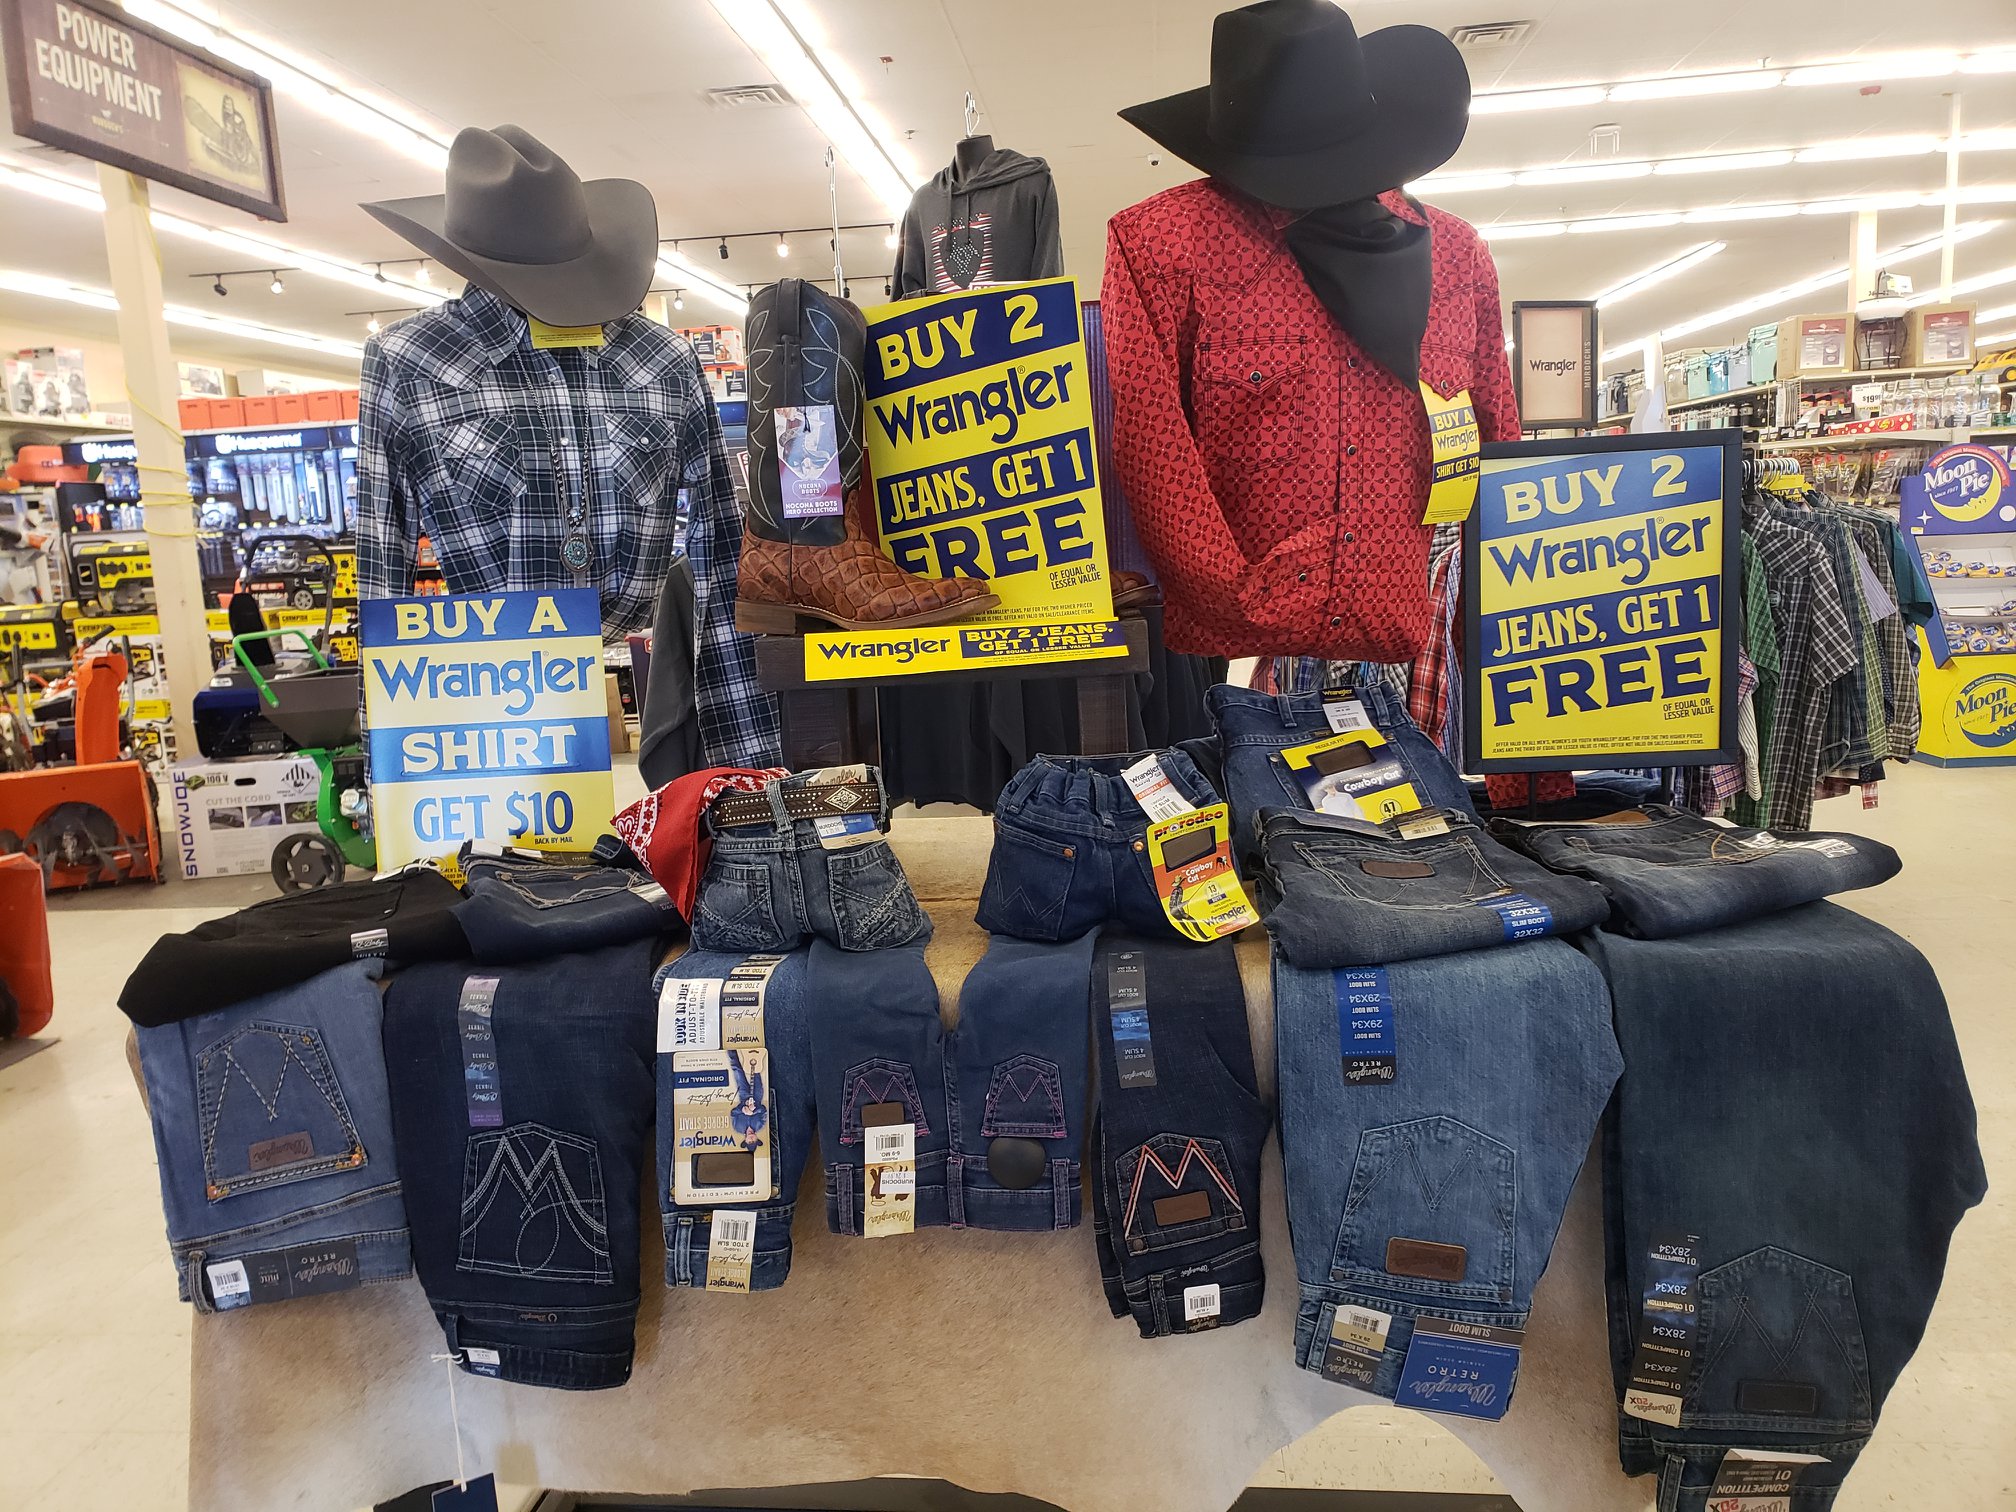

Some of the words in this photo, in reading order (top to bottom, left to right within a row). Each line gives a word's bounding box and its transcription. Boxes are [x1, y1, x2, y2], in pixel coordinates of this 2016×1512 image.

[55, 3, 137, 71] POWER
[34, 38, 162, 121] EQUIPMENT
[875, 307, 978, 382] BUY
[1003, 293, 1044, 346] 2
[1529, 359, 1577, 376] Wrangler
[873, 361, 1074, 449] Wrangler
[1433, 412, 1459, 431] BUY
[1464, 409, 1474, 423] A
[233, 431, 303, 453] Husqvarna
[1435, 429, 1478, 451] Wrangler
[1436, 462, 1455, 479] SHIRT
[1455, 459, 1468, 473] GET
[1469, 456, 1479, 470] $10
[889, 465, 987, 525] JEANS,
[992, 447, 1055, 500] GET
[1065, 437, 1087, 482] 1
[1923, 459, 1978, 493] Moon
[1501, 465, 1624, 525] BUY
[1650, 454, 1689, 498] 2
[1959, 472, 1990, 497] Pie
[802, 506, 838, 514] COLLECTION
[814, 500, 838, 508] BOOTS
[1488, 513, 1712, 586] Wrangler
[1049, 572, 1059, 582] OF
[1061, 566, 1085, 579] EQUAL
[1086, 563, 1097, 574] OR
[1051, 579, 1077, 590] LESSER
[1078, 572, 1102, 584] VALUE
[394, 598, 506, 641] BUY
[528, 596, 568, 633] A
[1492, 602, 1607, 658] JEANS,
[1616, 588, 1683, 633] GET
[1693, 583, 1712, 625] 1
[966, 629, 1012, 643] BUY
[1017, 628, 1031, 639] 2
[978, 639, 1022, 652] GET
[1031, 638, 1039, 648] 1
[1048, 633, 1105, 646] FREE
[818, 637, 950, 664] Wrangler
[371, 650, 596, 716] Wrangler
[1487, 637, 1712, 728] FREE
[1322, 689, 1353, 697] Wrangler
[1662, 703, 1673, 713] OF
[1674, 700, 1696, 712] EQUAL
[1698, 697, 1712, 708] OR
[1954, 687, 2007, 719] Moon
[1663, 709, 1690, 721] LESSER
[1691, 705, 1715, 717] VALUE
[1990, 700, 2016, 724] Pie
[402, 724, 577, 773] SHIRT
[1314, 741, 1337, 750] REGULAR
[206, 775, 221, 784] 100
[1129, 764, 1160, 784] Wrangler
[1344, 777, 1383, 792] Cowboy
[1383, 770, 1402, 780] Cut
[205, 798, 223, 806] CUT
[223, 796, 242, 804] THE
[244, 794, 271, 803] CORD
[1383, 801, 1396, 813] 47
[173, 771, 198, 876] SNOWJOE
[413, 794, 491, 843] GET
[505, 790, 574, 840] $10
[534, 836, 550, 845] BACK
[550, 836, 559, 844] BY
[559, 835, 574, 843] MAIL
[1185, 861, 1214, 876] Cowboy
[1187, 874, 1200, 883] Cut
[1207, 884, 1217, 893] 13
[1202, 904, 1247, 927] Wrangler
[1509, 907, 1541, 917] 32X32
[1511, 920, 1527, 928] SLIM
[1527, 916, 1546, 925] BOOT
[1513, 927, 1544, 939] 32X32
[1345, 972, 1377, 980] 29X34
[699, 983, 709, 1010] WAISTBAND
[1349, 993, 1380, 1004] 29X34
[675, 1017, 687, 1046] LOOK
[1351, 1019, 1383, 1029] 29X34
[726, 1033, 760, 1043] Wrangler
[690, 1075, 725, 1083] ORIGINAL
[1121, 1069, 1154, 1080] Wrangler
[1345, 1065, 1394, 1081] Wrangler
[677, 1116, 701, 1131] STRAIT
[703, 1115, 730, 1130] GEORGE
[679, 1131, 737, 1149] Wrangler
[867, 1209, 911, 1225] Wrangler
[301, 1252, 336, 1264] RETRO
[1650, 1252, 1686, 1263] COMPETITION
[1659, 1244, 1691, 1257] 28X34
[1686, 1257, 1697, 1266] 01
[294, 1257, 353, 1282] Wrangler
[709, 1276, 746, 1290] Wrangler
[1654, 1281, 1687, 1296] 28X34
[1646, 1299, 1683, 1310] COMPETITION
[1684, 1303, 1695, 1312] 01
[1448, 1323, 1470, 1335] BOOT
[1471, 1326, 1491, 1338] SLIM
[1652, 1325, 1687, 1340] 28X34
[1342, 1342, 1356, 1350] BOOT
[1356, 1346, 1370, 1354] SLIM
[1641, 1342, 1679, 1355] COMPETITION
[1680, 1349, 1691, 1358] 01
[1336, 1356, 1364, 1369] RETRO
[1644, 1362, 1679, 1373] 28X34
[1326, 1363, 1373, 1384] Wrangler
[1427, 1365, 1479, 1380] RETRO
[1632, 1376, 1670, 1388] COMPETITION
[1670, 1381, 1681, 1390] 01
[1409, 1375, 1497, 1406] Wrangler
[1629, 1396, 1649, 1405] 20X
[1633, 1401, 1678, 1416] Wrangler
[1775, 1470, 1792, 1481] 01
[1716, 1483, 1790, 1494] COMPETITION
